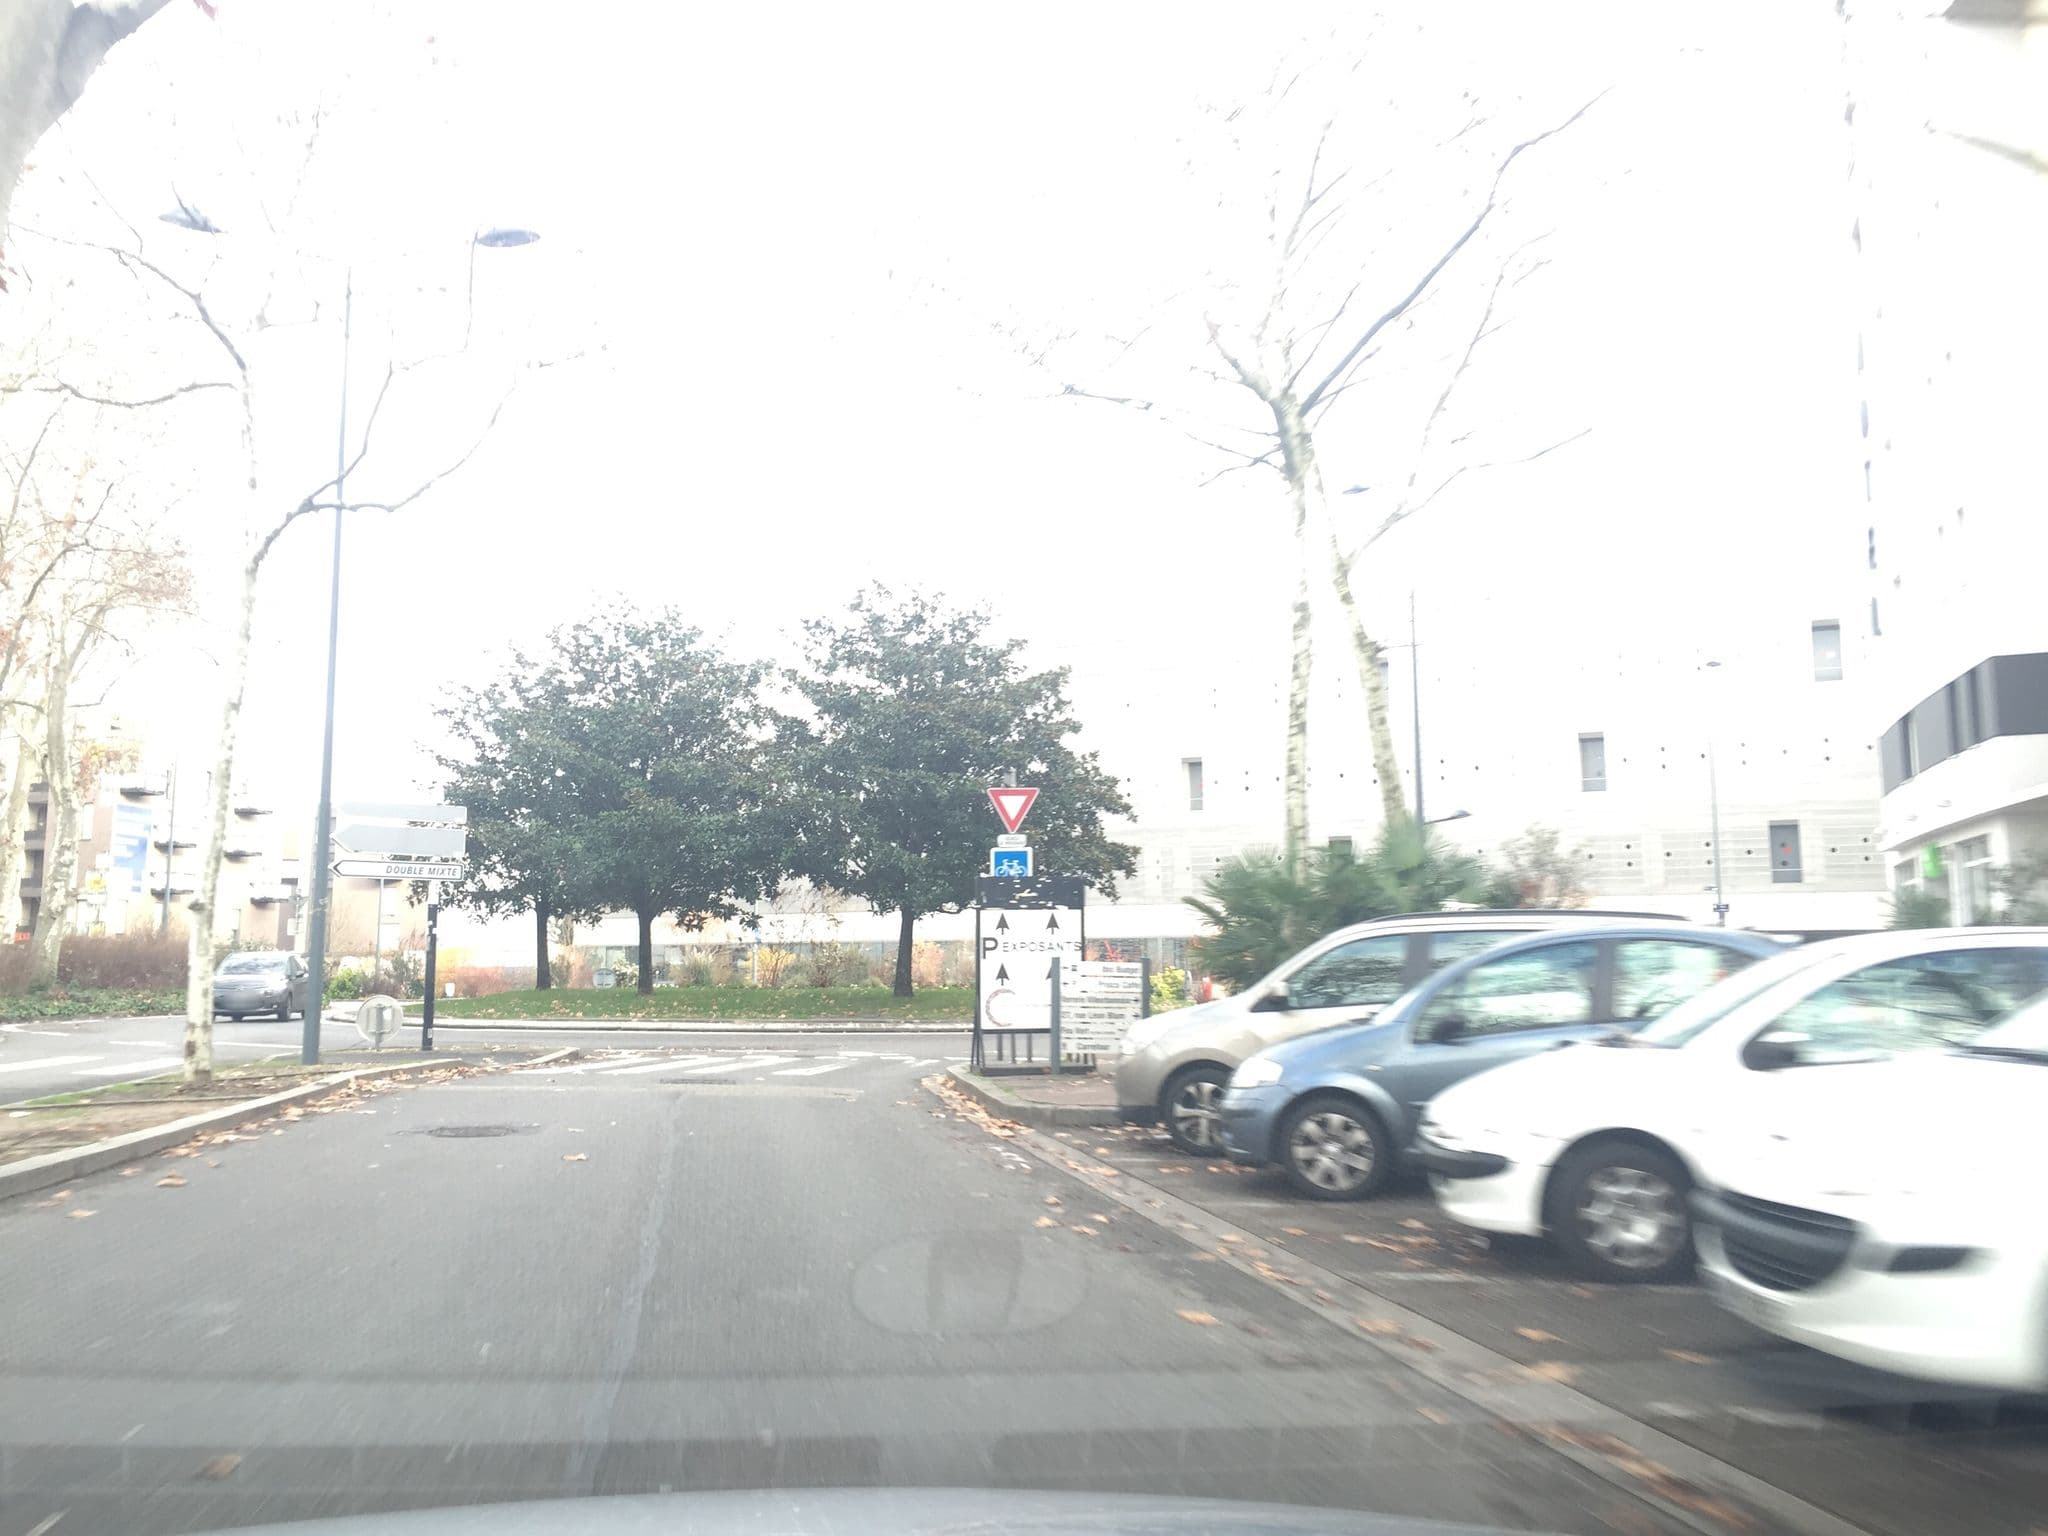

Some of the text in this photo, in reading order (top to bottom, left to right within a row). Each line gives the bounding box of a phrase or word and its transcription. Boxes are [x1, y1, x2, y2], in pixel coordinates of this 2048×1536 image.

[386, 865, 458, 877] DOUBLE MIXTE
[982, 937, 1082, 960] P EXPOSANTS
